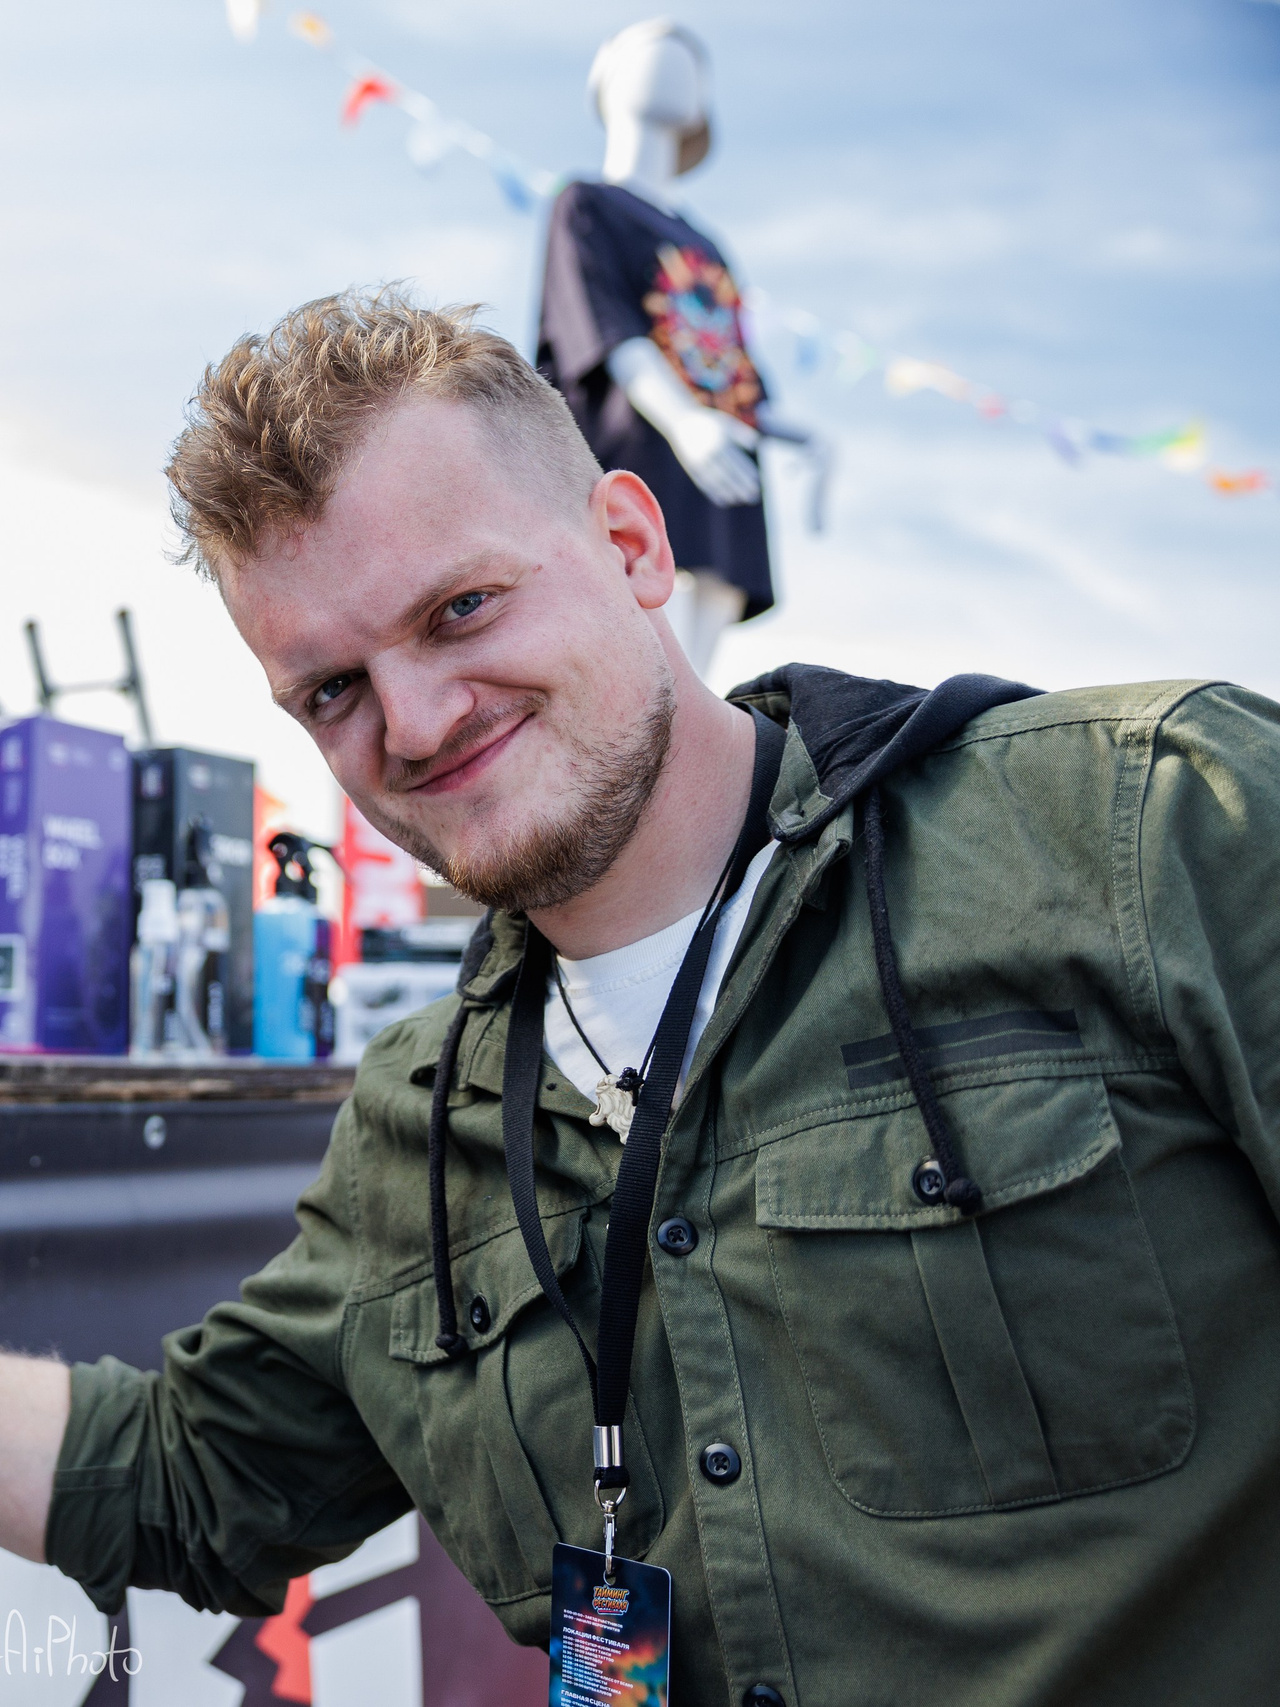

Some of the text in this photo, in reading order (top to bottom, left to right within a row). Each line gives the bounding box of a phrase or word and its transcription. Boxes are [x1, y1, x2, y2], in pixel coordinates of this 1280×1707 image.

[594, 1585, 629, 1600] ТАЙМИНГ
[593, 1599, 628, 1611] ФЕСТИВАЛЯ
[563, 1626, 630, 1650] ЛОКАЦИИ ФЕСТИВАЛЯ
[561, 1689, 589, 1702] ГЛАВНАЯ
